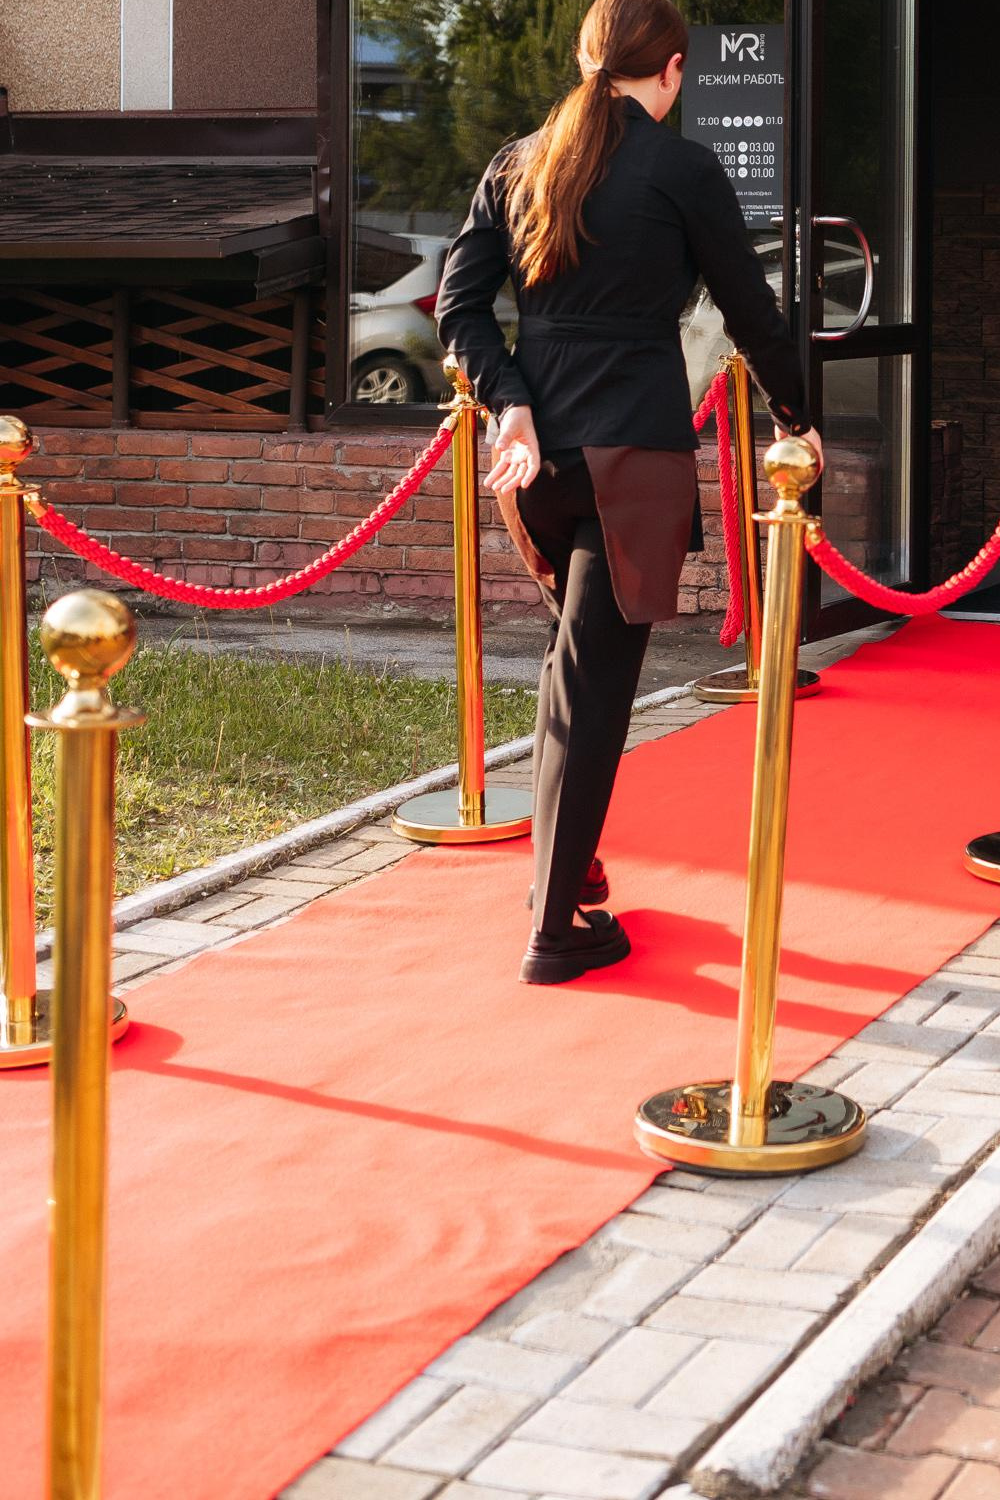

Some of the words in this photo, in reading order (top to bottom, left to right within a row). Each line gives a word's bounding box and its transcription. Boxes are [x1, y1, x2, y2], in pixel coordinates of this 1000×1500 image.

[698, 74, 741, 85] РЕЖИМ
[697, 117, 720, 126] 12.00
[765, 116, 784, 125] 01.0
[712, 142, 736, 153] 12.00
[749, 142, 775, 152] 03.00
[749, 155, 775, 165] 03.00
[751, 168, 775, 178] 01.00
